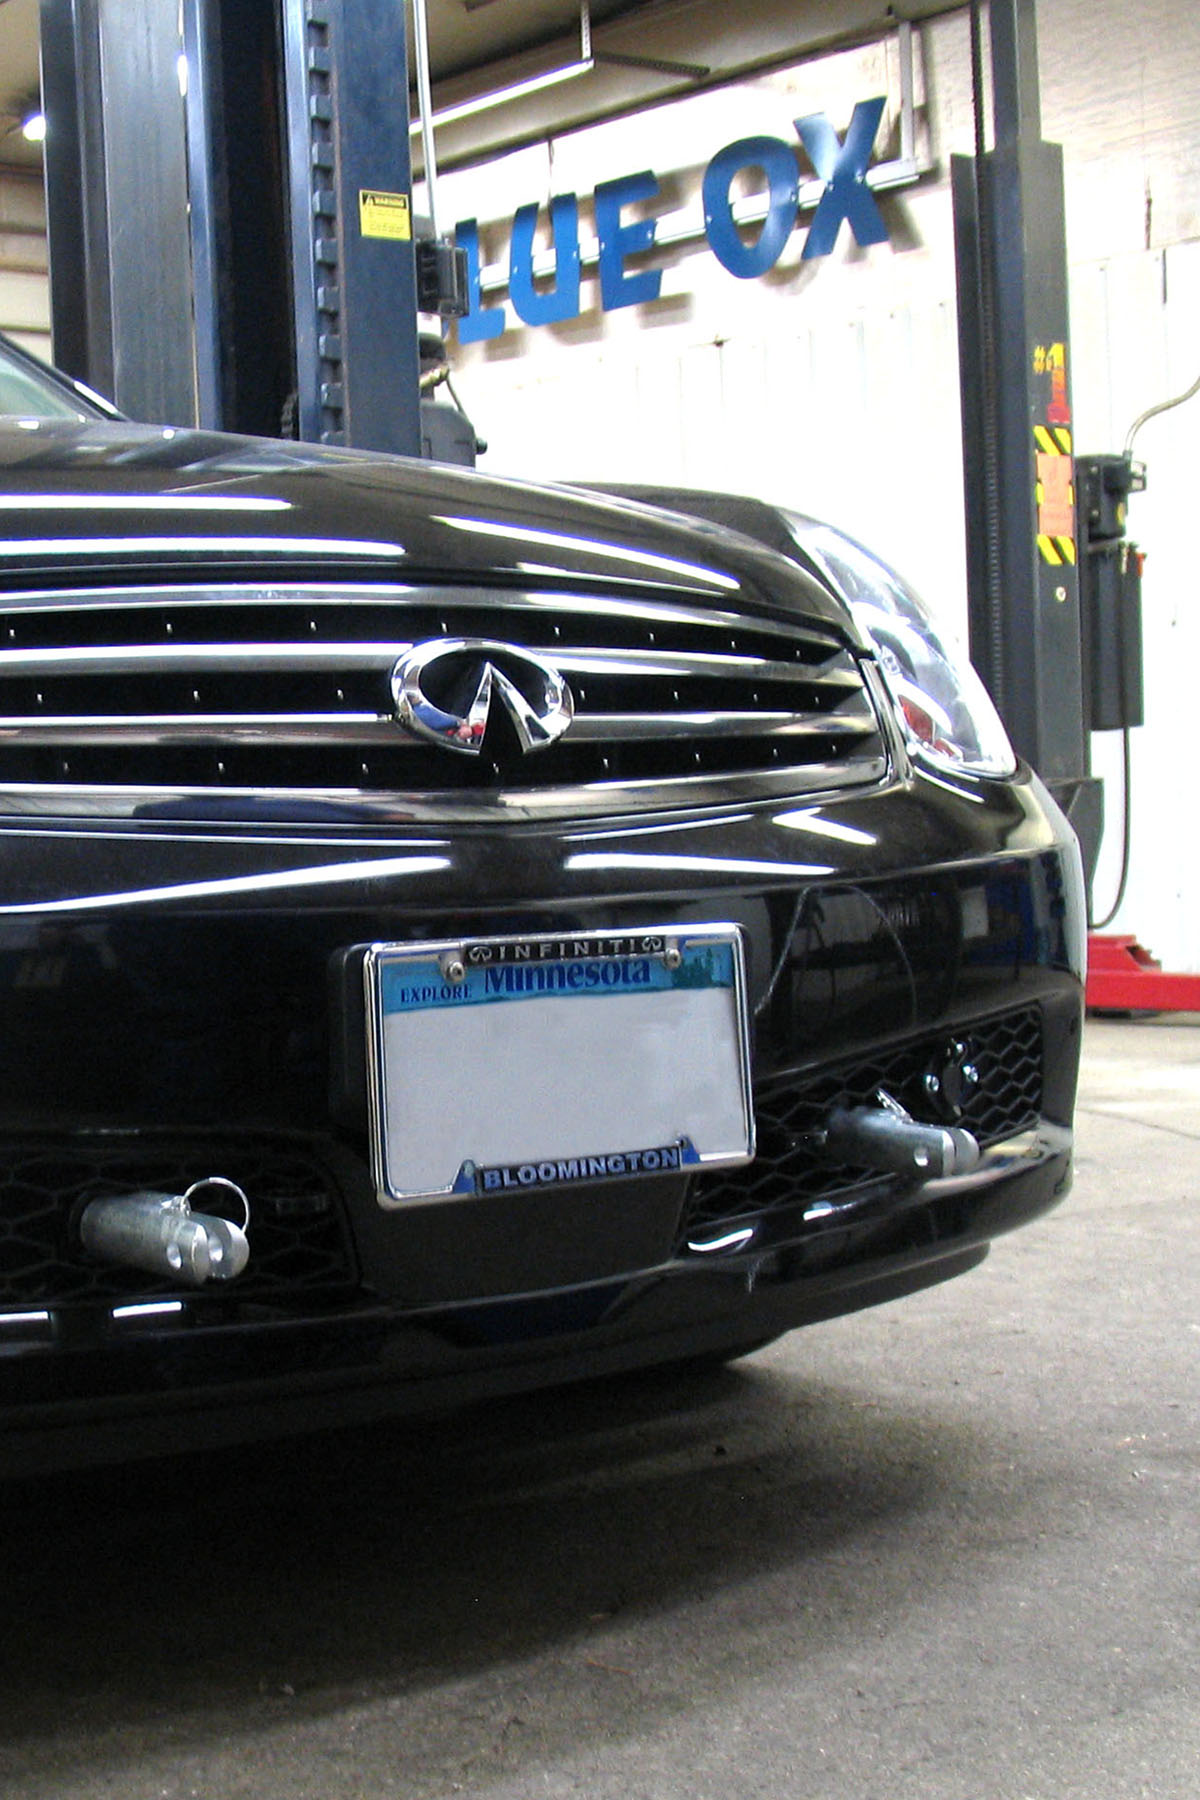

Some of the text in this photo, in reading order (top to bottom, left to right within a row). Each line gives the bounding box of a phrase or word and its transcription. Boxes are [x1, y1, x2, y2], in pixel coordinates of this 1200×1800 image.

[442, 95, 890, 345] LUE OX
[500, 938, 635, 960] INFINITI
[401, 957, 650, 1003] EXPLORE Minnesota
[483, 1148, 678, 1189] BLOOMINGTON
